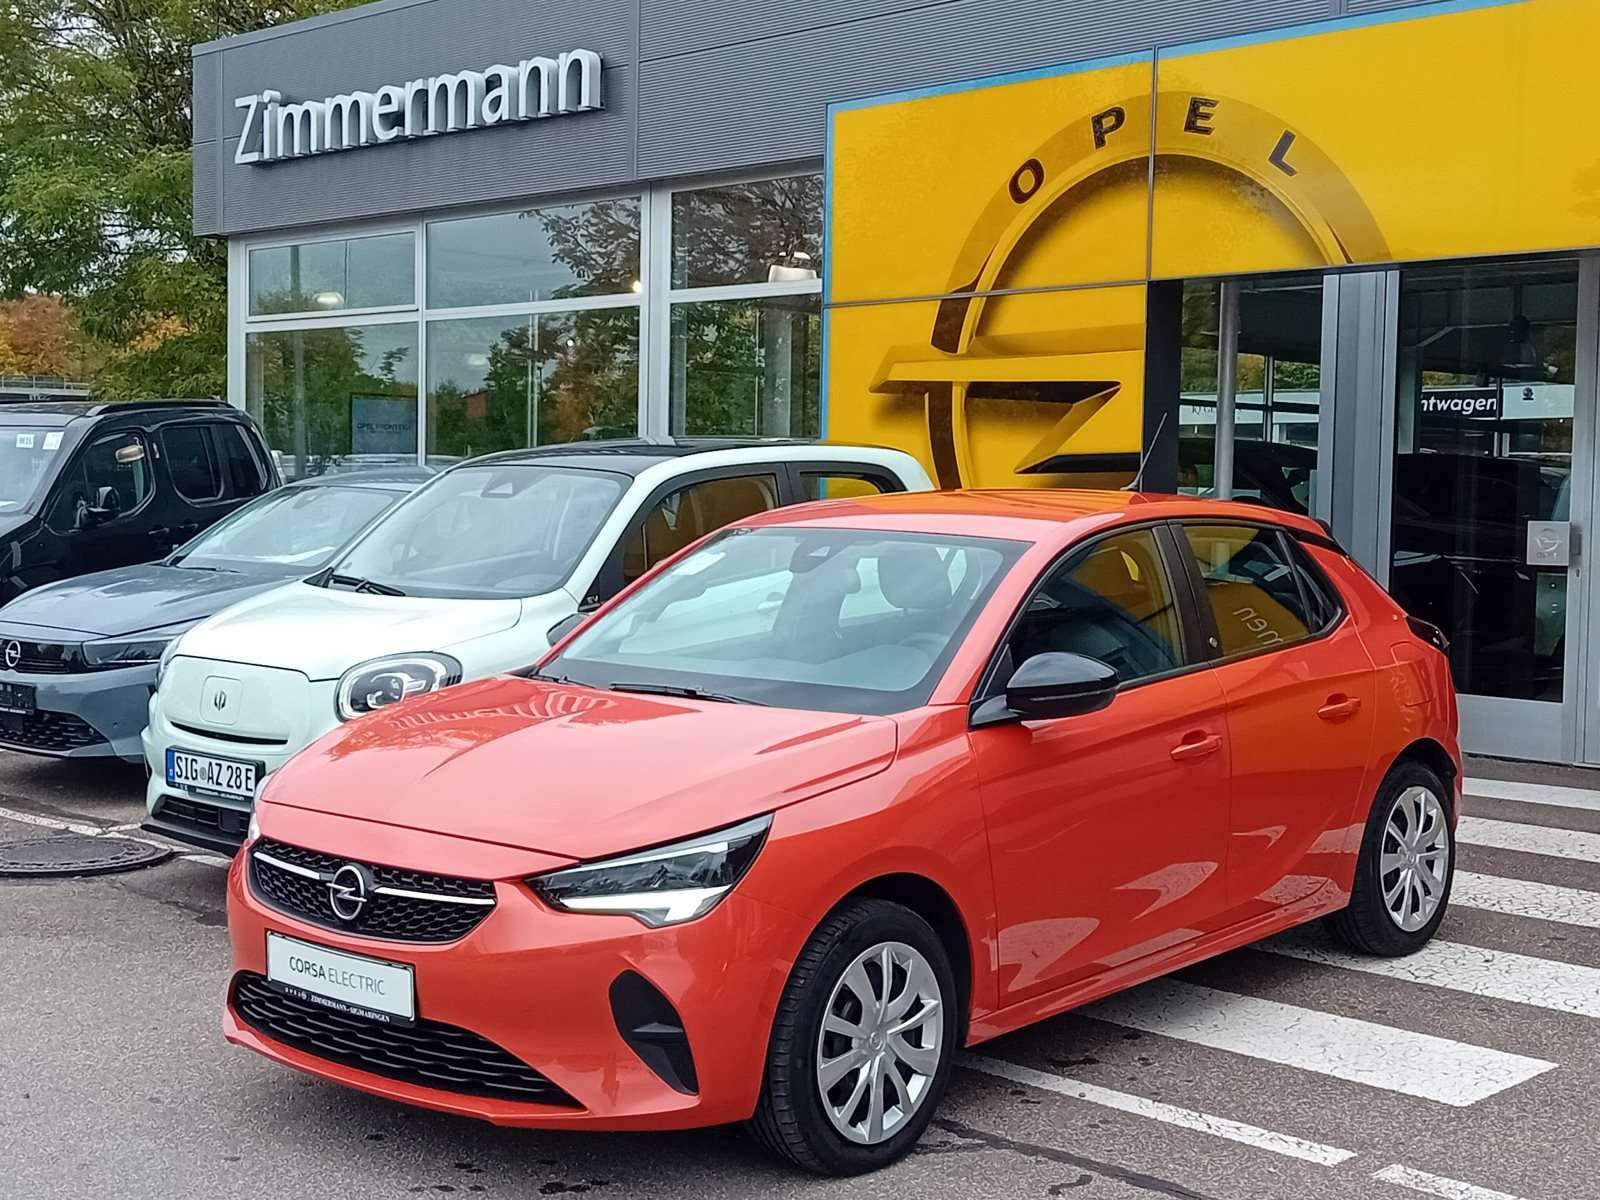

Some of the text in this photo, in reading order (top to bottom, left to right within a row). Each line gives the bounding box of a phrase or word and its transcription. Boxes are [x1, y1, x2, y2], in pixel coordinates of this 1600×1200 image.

[235, 49, 602, 164] Zimmermann
[1008, 96, 1298, 204] OPEL
[175, 756, 198, 781] SIG
[207, 761, 222, 786] AZ
[289, 956, 327, 980] CORSA
[328, 967, 386, 995] ELECTRIC
